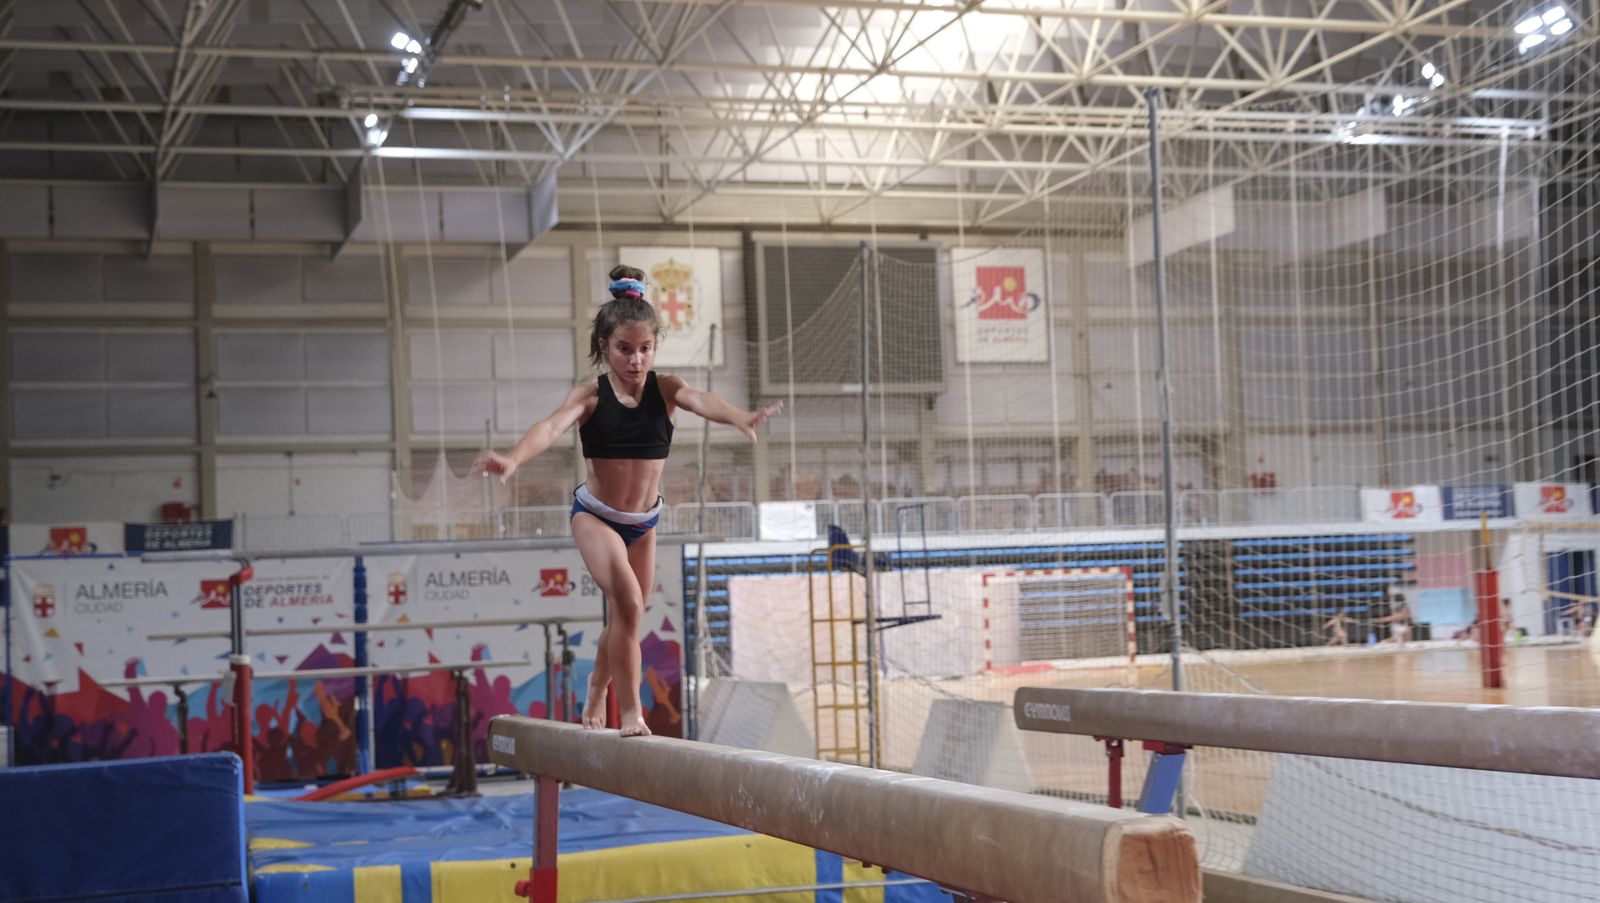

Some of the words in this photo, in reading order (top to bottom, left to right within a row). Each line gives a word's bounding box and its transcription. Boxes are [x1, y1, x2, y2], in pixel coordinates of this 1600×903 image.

[424, 566, 512, 588] ALMERÍA
[75, 577, 169, 600] ALMERÍA
[243, 583, 323, 596] DEPORTES
[244, 598, 265, 609] DE
